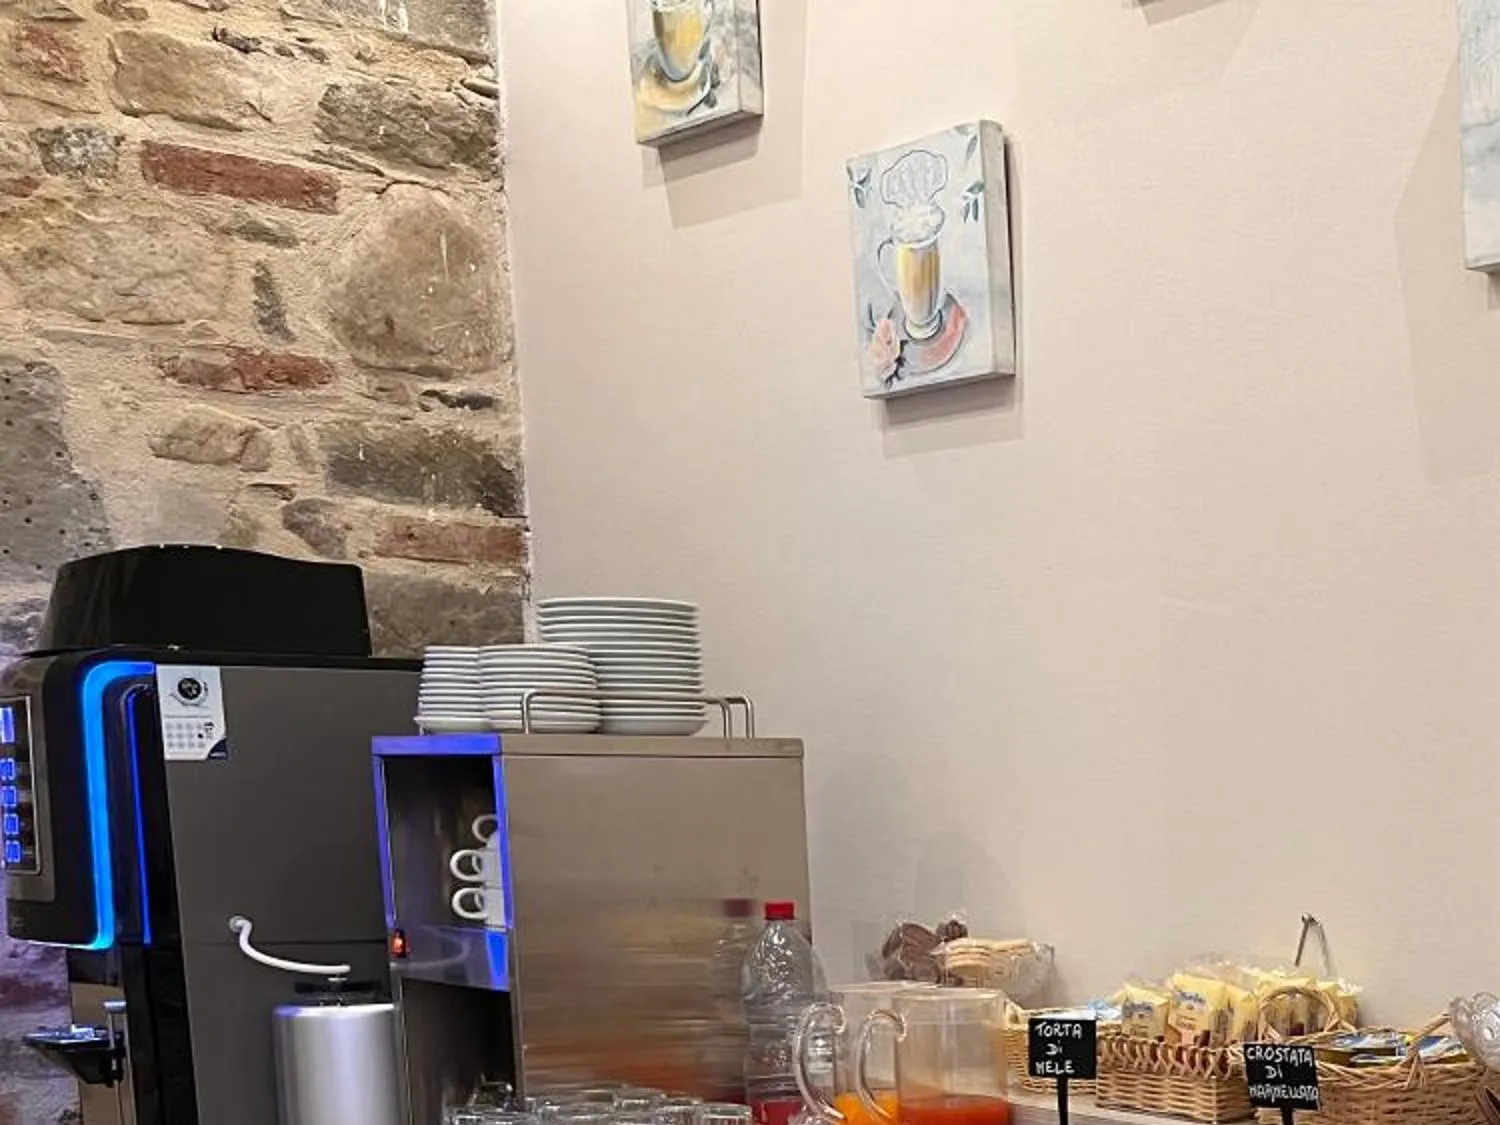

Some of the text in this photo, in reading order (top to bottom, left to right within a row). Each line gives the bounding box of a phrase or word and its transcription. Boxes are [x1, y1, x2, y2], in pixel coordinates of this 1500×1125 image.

[1035, 1021, 1083, 1039] TORTA
[1246, 1046, 1313, 1067] CROSTATA
[1035, 1060, 1075, 1075] MELE
